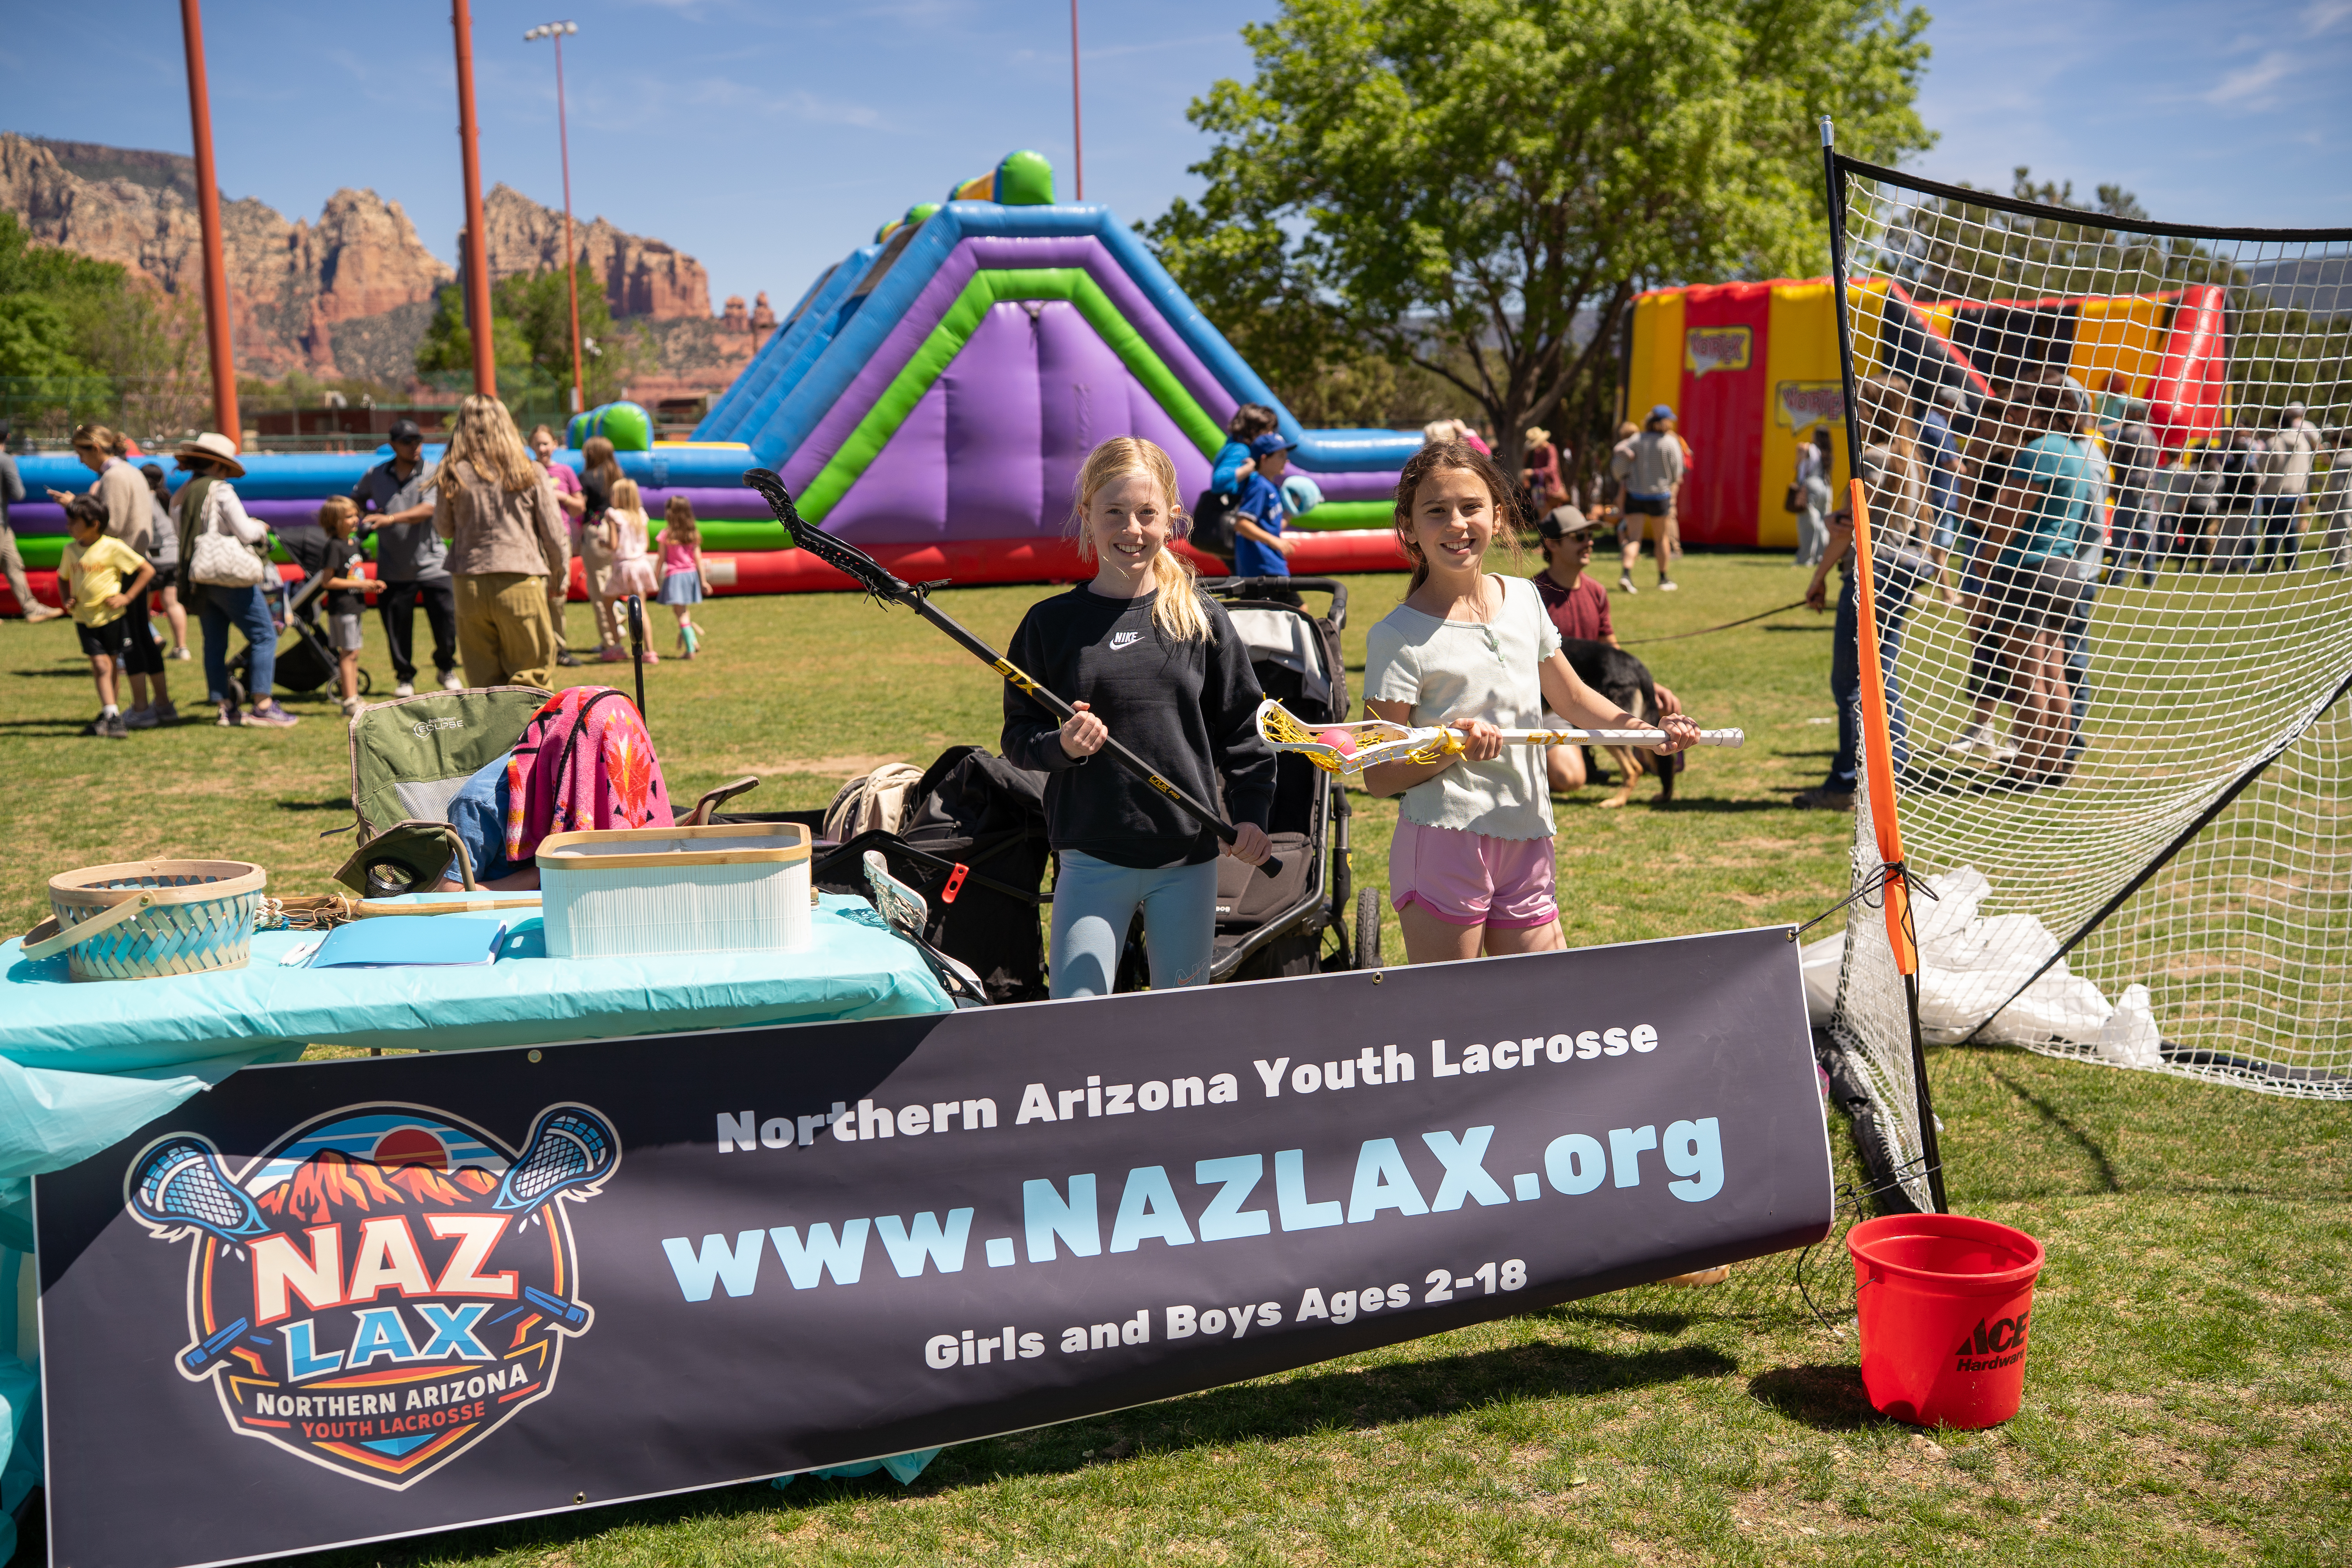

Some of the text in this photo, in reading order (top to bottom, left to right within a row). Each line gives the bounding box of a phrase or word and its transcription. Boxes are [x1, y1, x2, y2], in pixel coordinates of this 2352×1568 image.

[1114, 632, 1138, 642] NIKE
[989, 657, 1043, 697] STX
[418, 720, 464, 733] ECLIPSE
[1525, 732, 1569, 745] STX
[1169, 790, 1180, 799] PRO
[717, 1024, 1658, 1154] Northern Arizona Youth Lacrosse
[661, 1117, 1725, 1303] www.NAZLAX.org
[245, 1213, 519, 1328] NAZ
[925, 1258, 1527, 1369] Girls and Boys Ages 2-18
[1955, 1309, 2029, 1356] ACE
[276, 1303, 497, 1383] LAX
[1956, 1348, 2024, 1372] Hardware
[256, 1363, 528, 1417] NORTHERN ARIZONA
[301, 1401, 486, 1438] YOUTH LACROSSE
